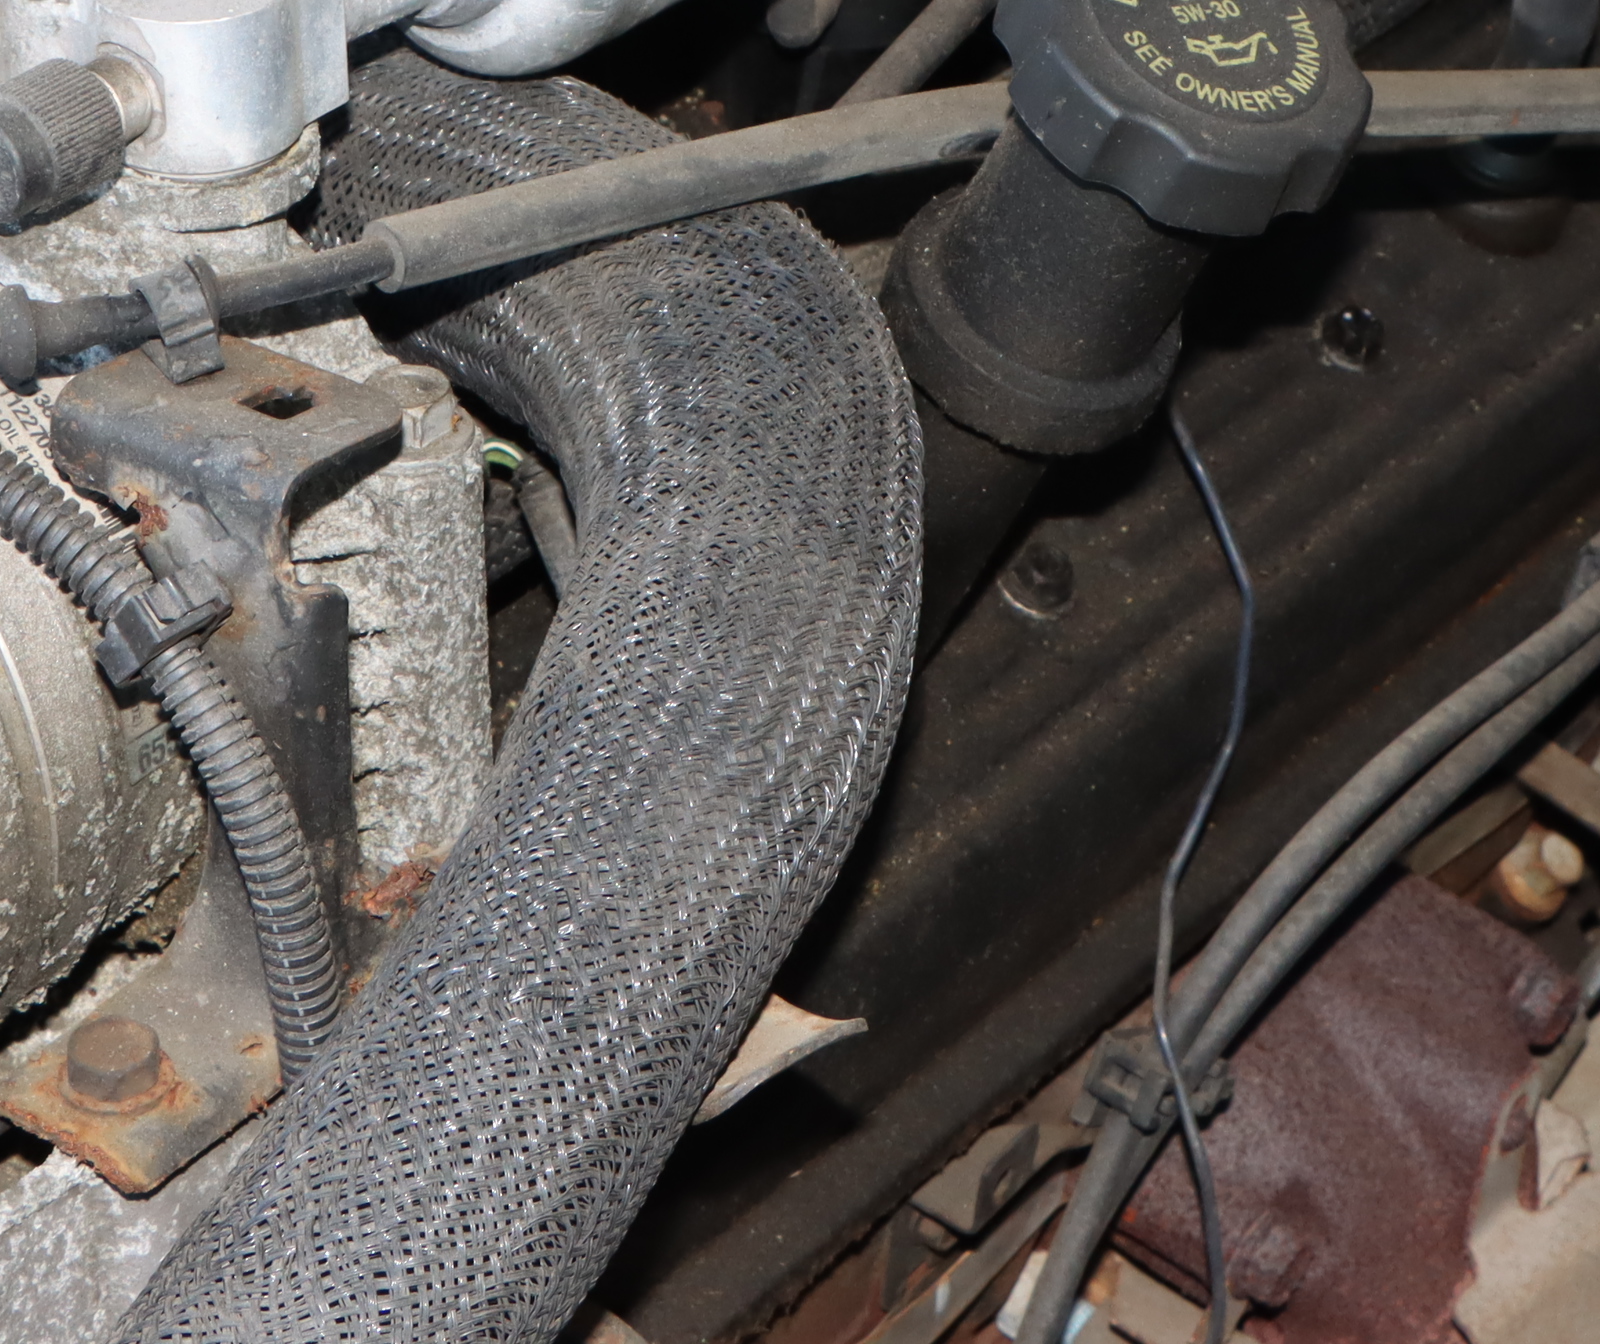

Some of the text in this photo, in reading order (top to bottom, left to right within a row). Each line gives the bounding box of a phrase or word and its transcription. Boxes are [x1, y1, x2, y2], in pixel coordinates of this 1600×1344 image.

[1171, 0, 1240, 24] 5W-30
[1123, 6, 1320, 112] SEE OWNER'S MANUAL
